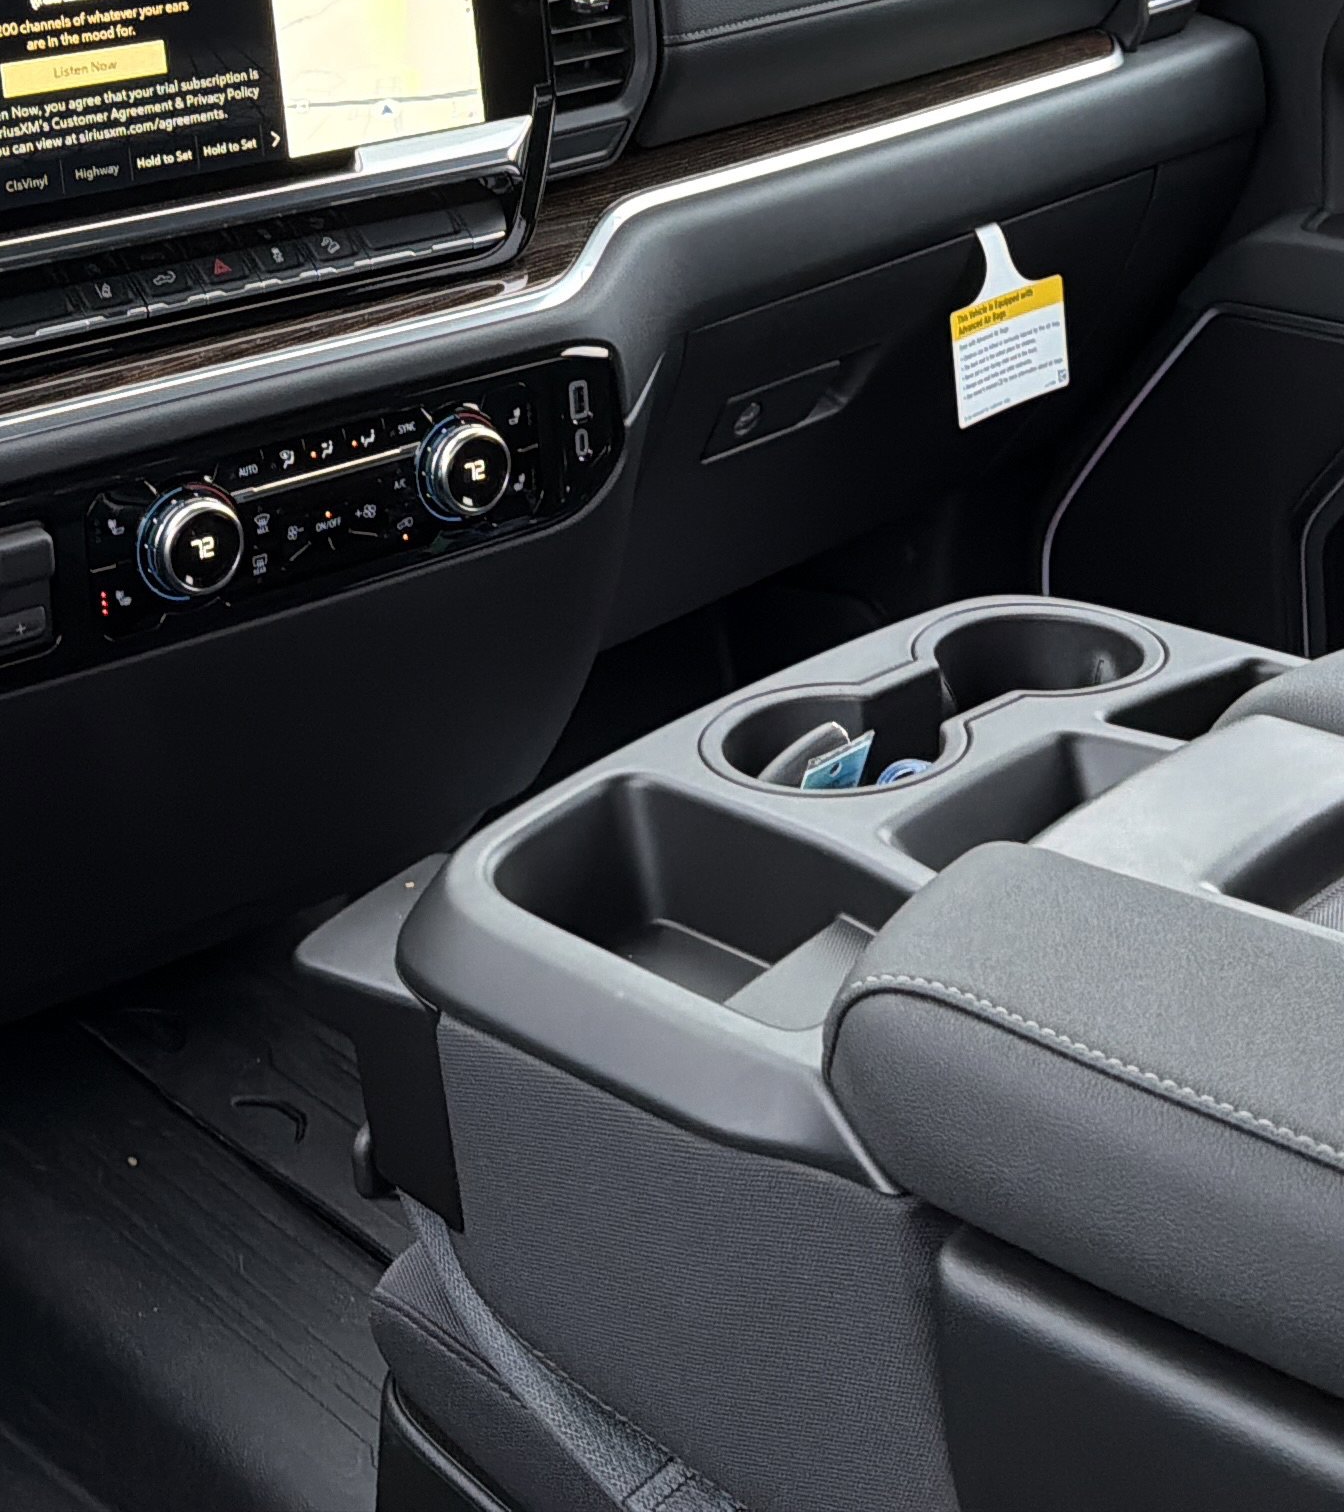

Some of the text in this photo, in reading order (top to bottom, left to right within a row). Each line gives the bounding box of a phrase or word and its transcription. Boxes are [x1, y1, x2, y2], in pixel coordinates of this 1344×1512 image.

[20, 15, 71, 35] channels
[73, 11, 86, 27] of
[87, 7, 138, 25] whatever
[139, 4, 163, 21] your
[165, 0, 190, 14] ears
[26, 22, 137, 52] are in the mood for.
[53, 59, 118, 79] Listen Now
[11, 103, 42, 118] Now,
[43, 100, 66, 117] you
[68, 93, 102, 112] agree
[103, 87, 128, 104] that
[129, 85, 155, 104] your
[156, 81, 179, 96] trial
[180, 71, 248, 92] subscription
[249, 68, 259, 81] is
[51, 111, 108, 131] Customer
[110, 100, 173, 122] Agreement
[174, 97, 185, 110] &
[186, 90, 225, 108] Privacy
[227, 85, 260, 102] Policy
[12, 142, 35, 156] can
[35, 136, 64, 151] view
[64, 133, 78, 146] at
[78, 108, 229, 144] siriusxm.com/agreements.
[136, 148, 193, 169] Hold to Set
[203, 138, 258, 157] Hold to Set
[74, 162, 120, 181] Highway
[5, 175, 49, 194] ClsVinyl
[956, 313, 969, 323] This
[969, 304, 987, 319] Vehicle
[994, 292, 1020, 309] Equipped
[958, 310, 1007, 335] Advanced Air Bags
[397, 420, 416, 435] SYNC
[238, 464, 259, 478] AUTO
[463, 459, 486, 481] 72
[315, 516, 342, 533] ON/OFF
[190, 536, 216, 561] 72
